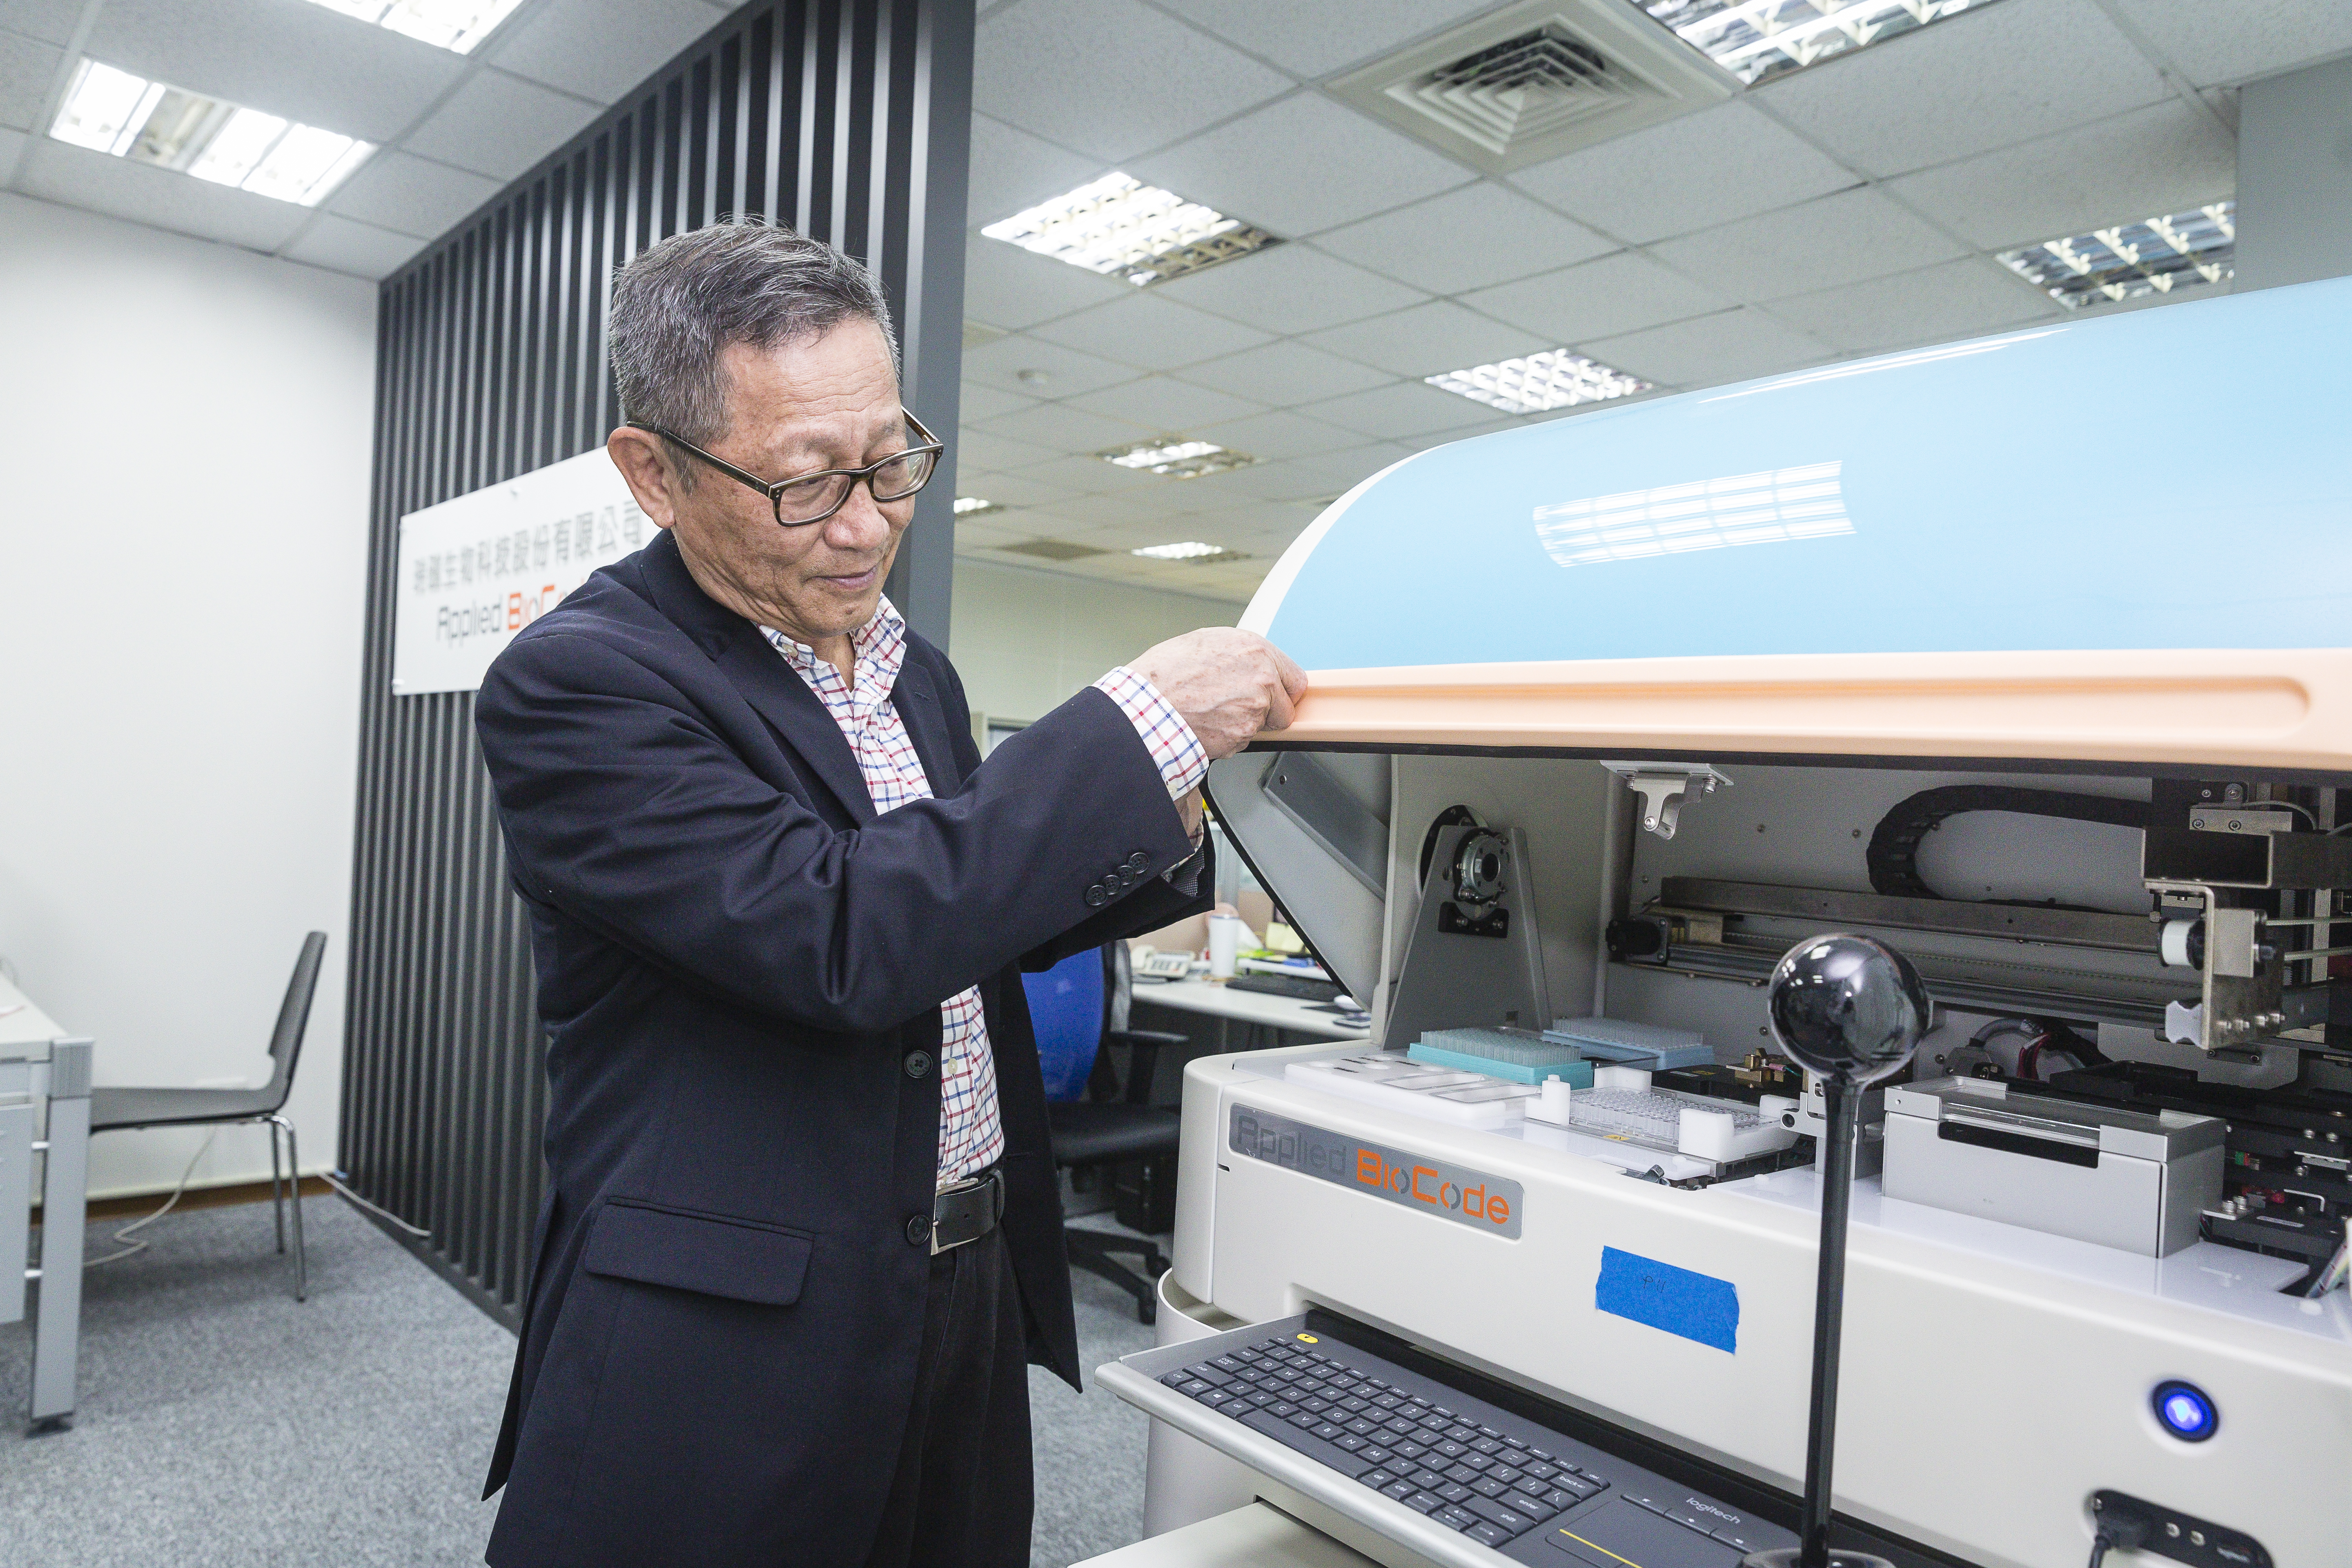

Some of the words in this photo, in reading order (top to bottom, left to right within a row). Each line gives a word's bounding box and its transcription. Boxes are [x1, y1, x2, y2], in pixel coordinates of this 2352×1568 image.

[414, 499, 643, 593] 生物科技股份有限公司
[437, 595, 502, 648] Applied
[508, 577, 584, 630] BioC
[1237, 1115, 1347, 1176] Applied
[1356, 1148, 1510, 1224] BioCode
[1686, 1497, 1741, 1523] logitech
